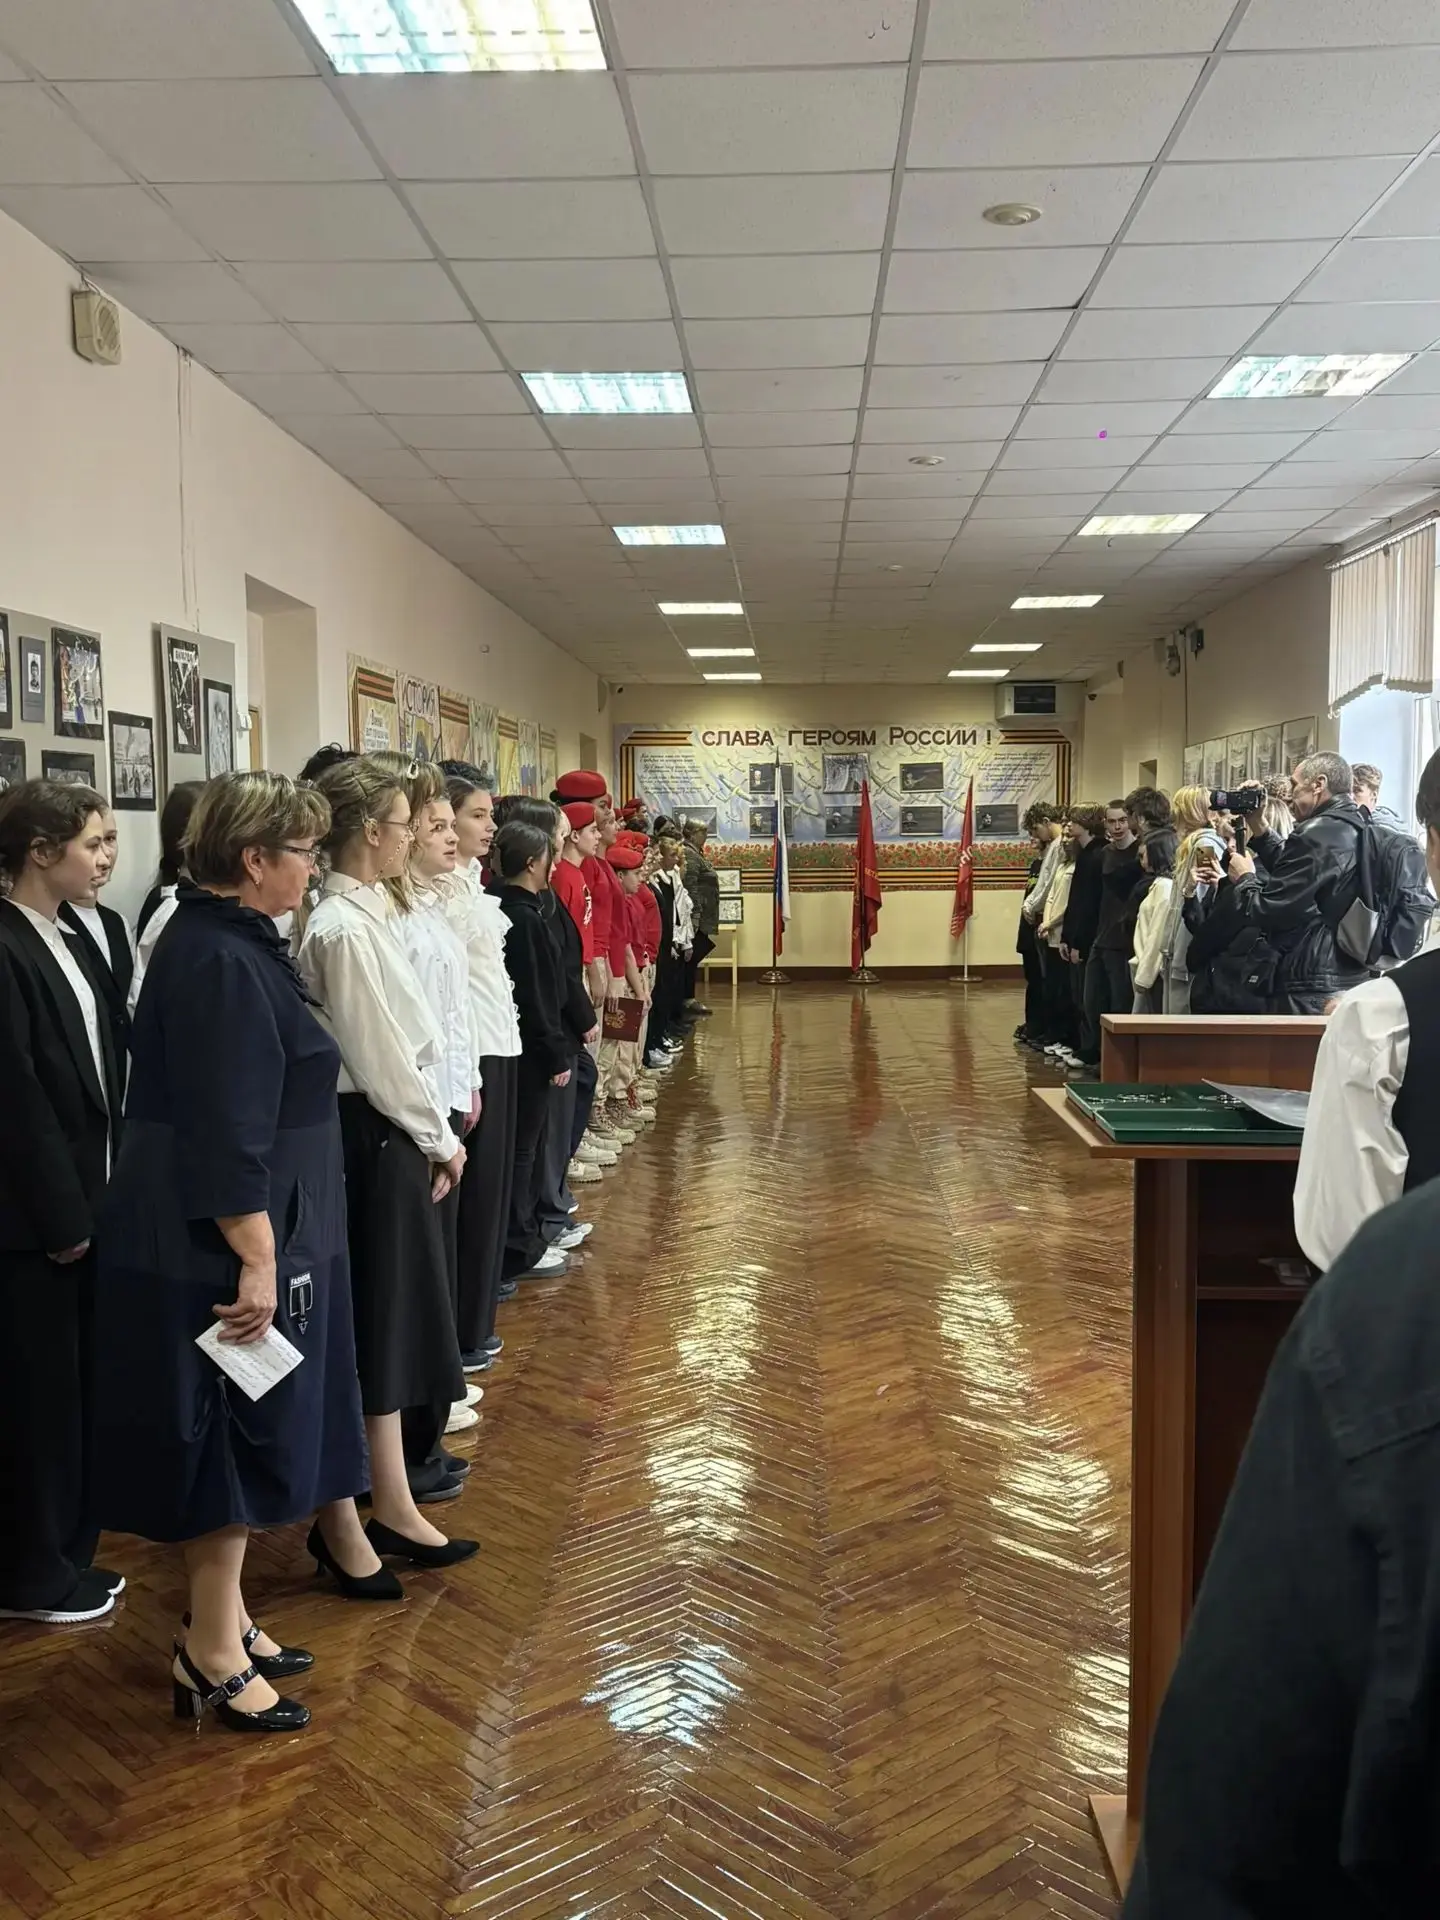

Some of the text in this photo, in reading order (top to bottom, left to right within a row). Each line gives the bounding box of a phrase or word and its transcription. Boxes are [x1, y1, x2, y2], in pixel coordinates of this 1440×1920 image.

[403, 679, 436, 717] ИСТОРИЯ
[701, 730, 774, 746] СЛАВА
[788, 729, 877, 746] ГЕРОЯМ
